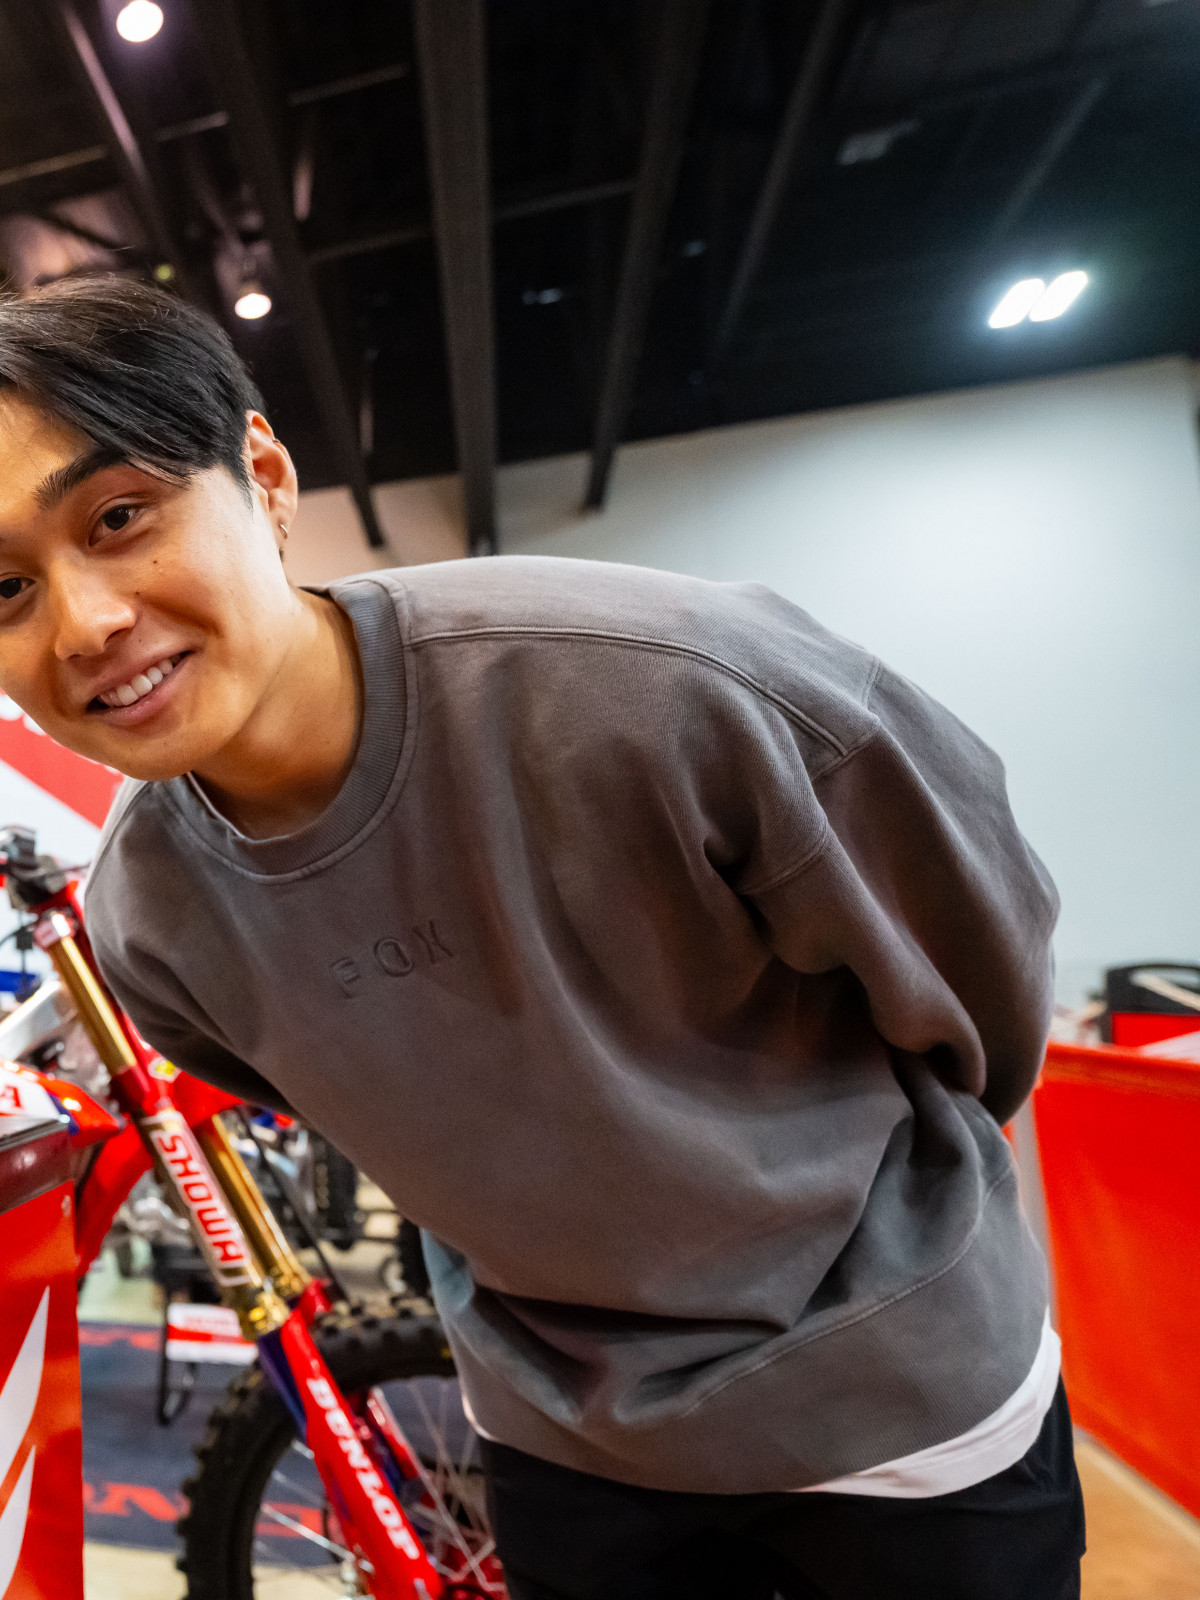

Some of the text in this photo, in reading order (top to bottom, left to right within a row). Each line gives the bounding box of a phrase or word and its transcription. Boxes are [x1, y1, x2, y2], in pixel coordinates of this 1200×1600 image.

[329, 919, 454, 999] FOX
[157, 1135, 244, 1262] SHOWA
[306, 1377, 421, 1560] DUNLOP
